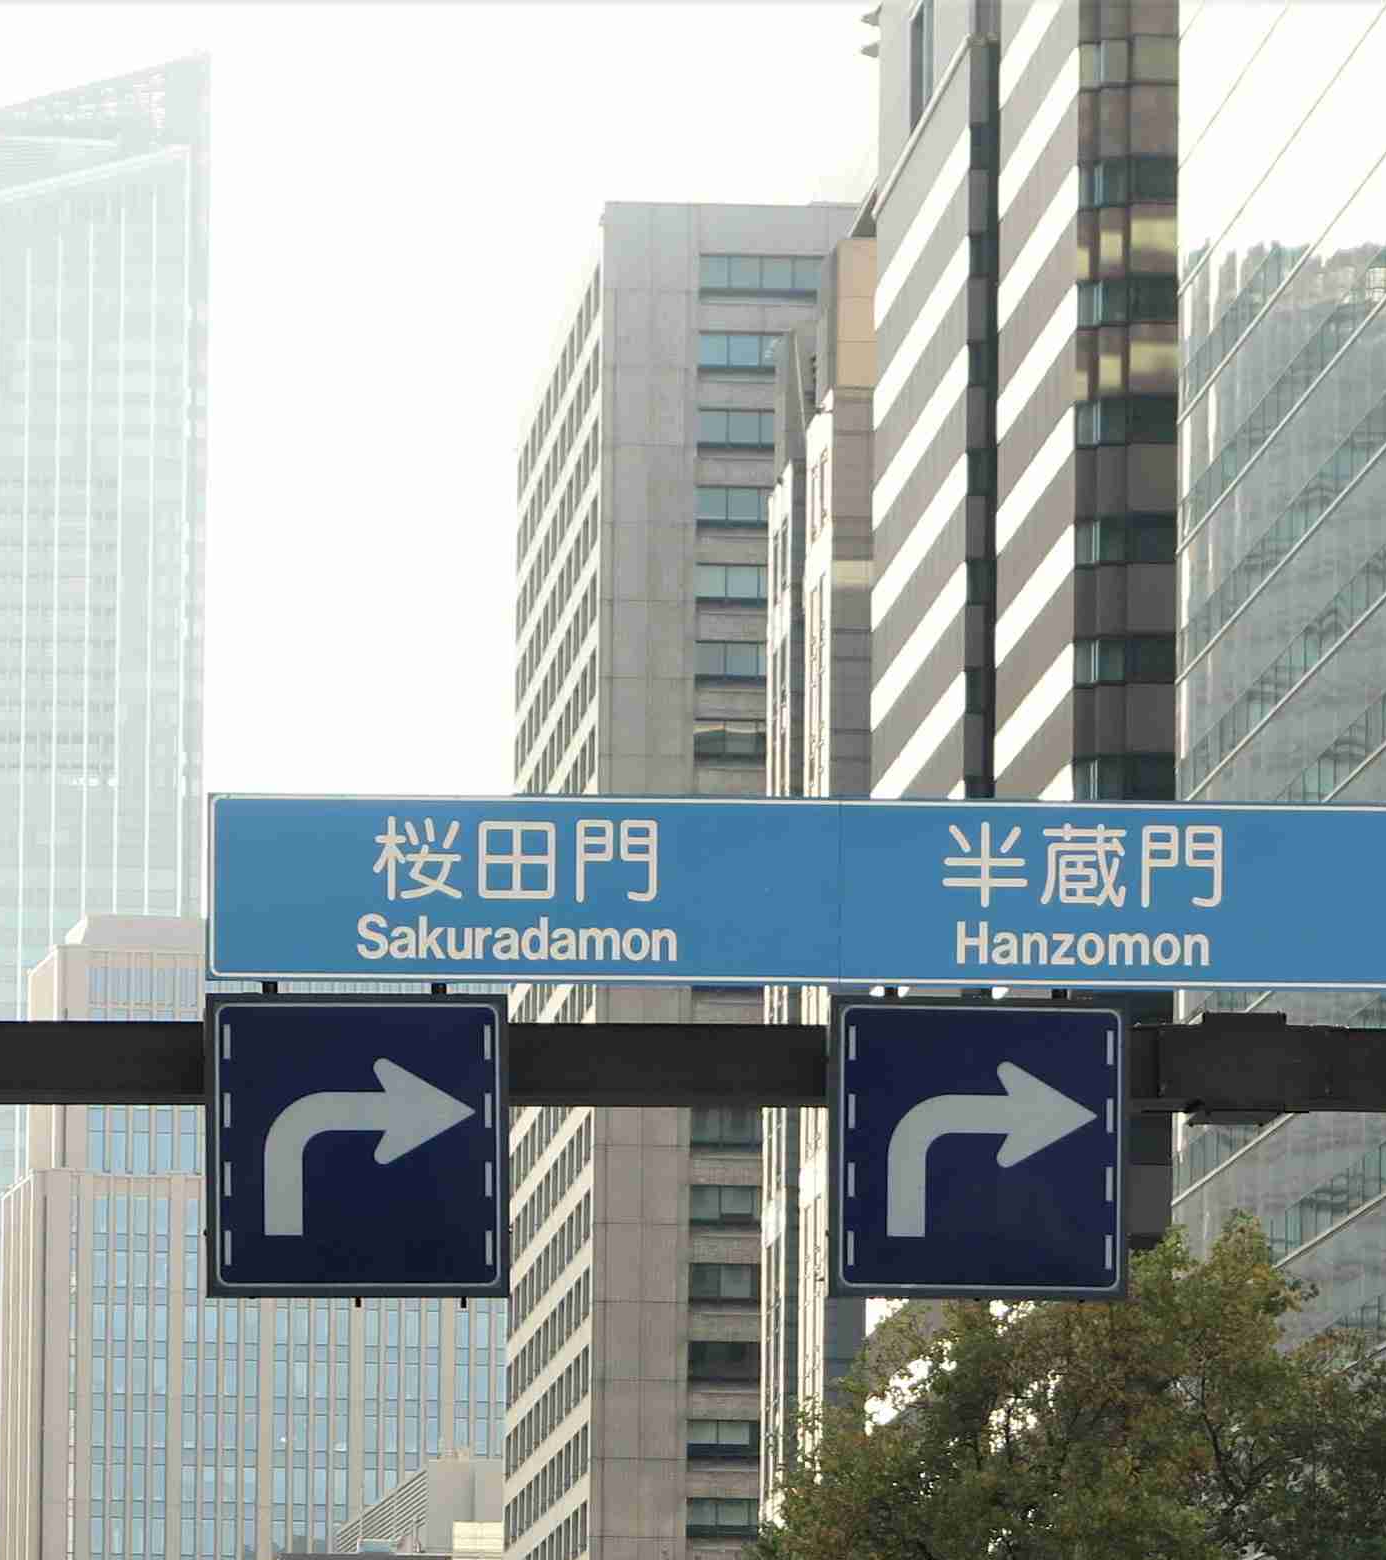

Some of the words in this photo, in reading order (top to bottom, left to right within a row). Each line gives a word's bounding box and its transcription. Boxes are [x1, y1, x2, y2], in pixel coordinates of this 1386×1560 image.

[372, 815, 659, 903] 桜田門
[942, 821, 1224, 908] 半蔵門
[356, 913, 679, 962] Sakuradamon
[955, 920, 1211, 967] Hanzomon
